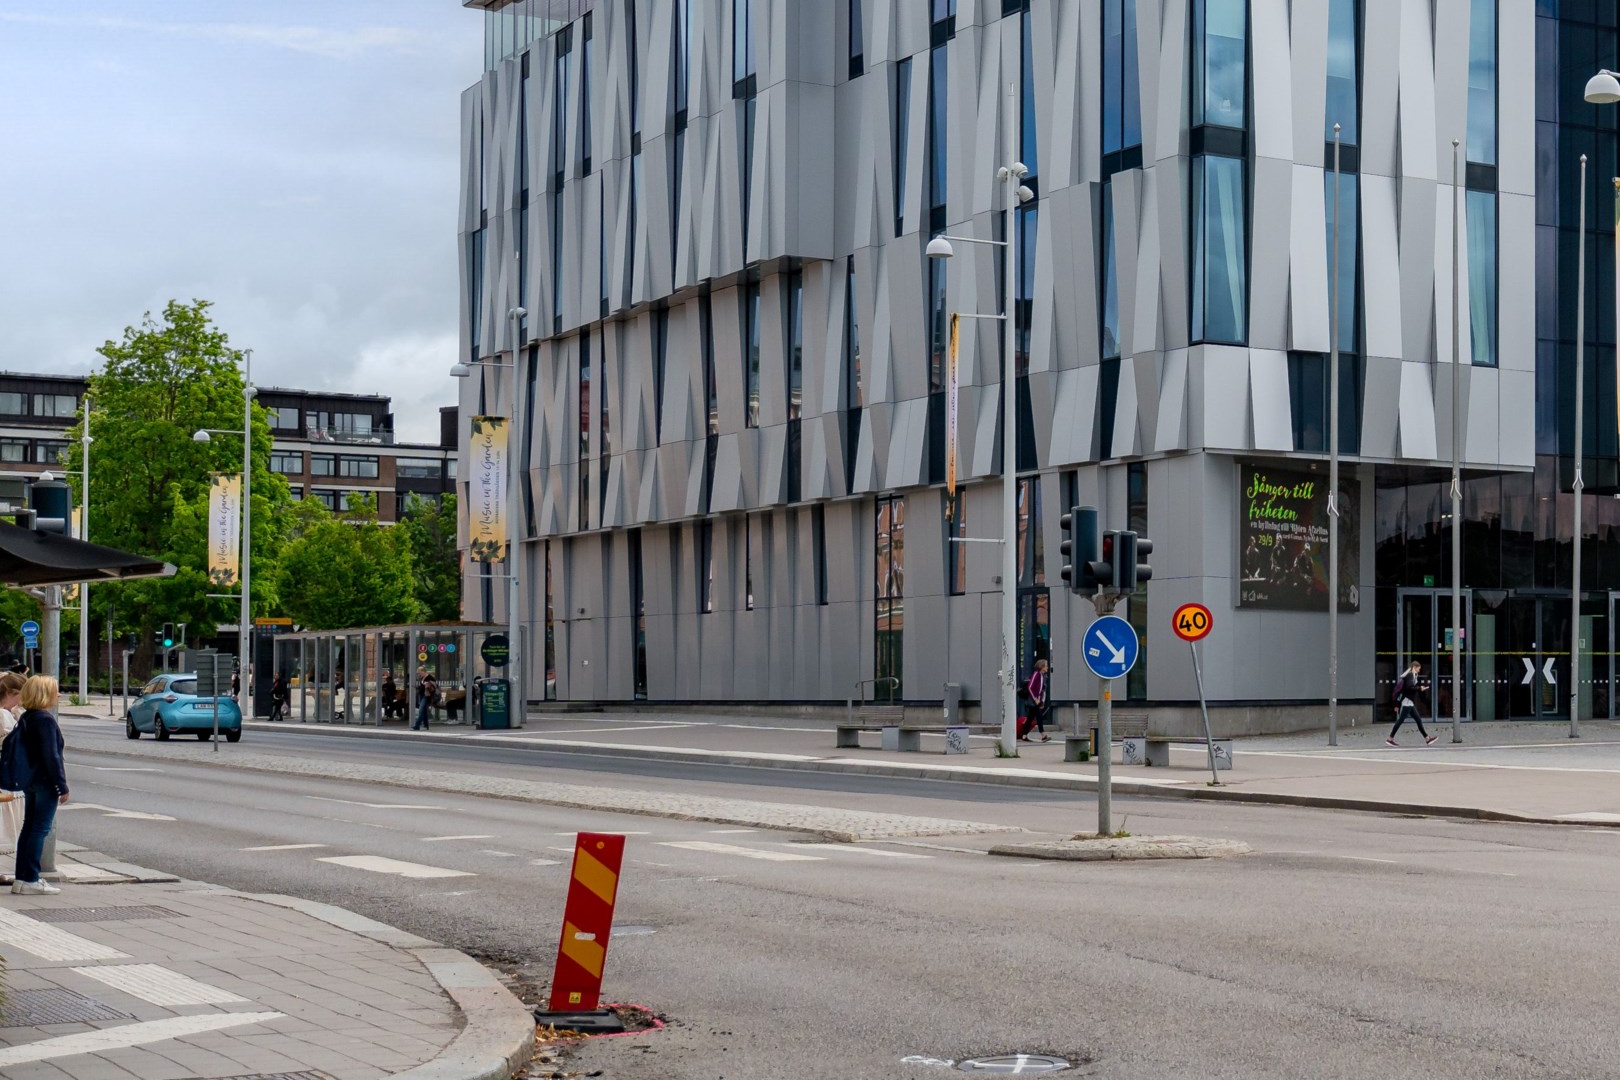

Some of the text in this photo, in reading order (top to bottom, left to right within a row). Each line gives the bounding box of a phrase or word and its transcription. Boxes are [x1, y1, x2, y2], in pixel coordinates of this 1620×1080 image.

[481, 434, 495, 470] Garden
[1247, 473, 1315, 501] Sånger till
[479, 500, 493, 536] Music
[1249, 500, 1299, 520] friheten
[1258, 534, 1273, 546] 29/9
[1179, 612, 1207, 632] 40
